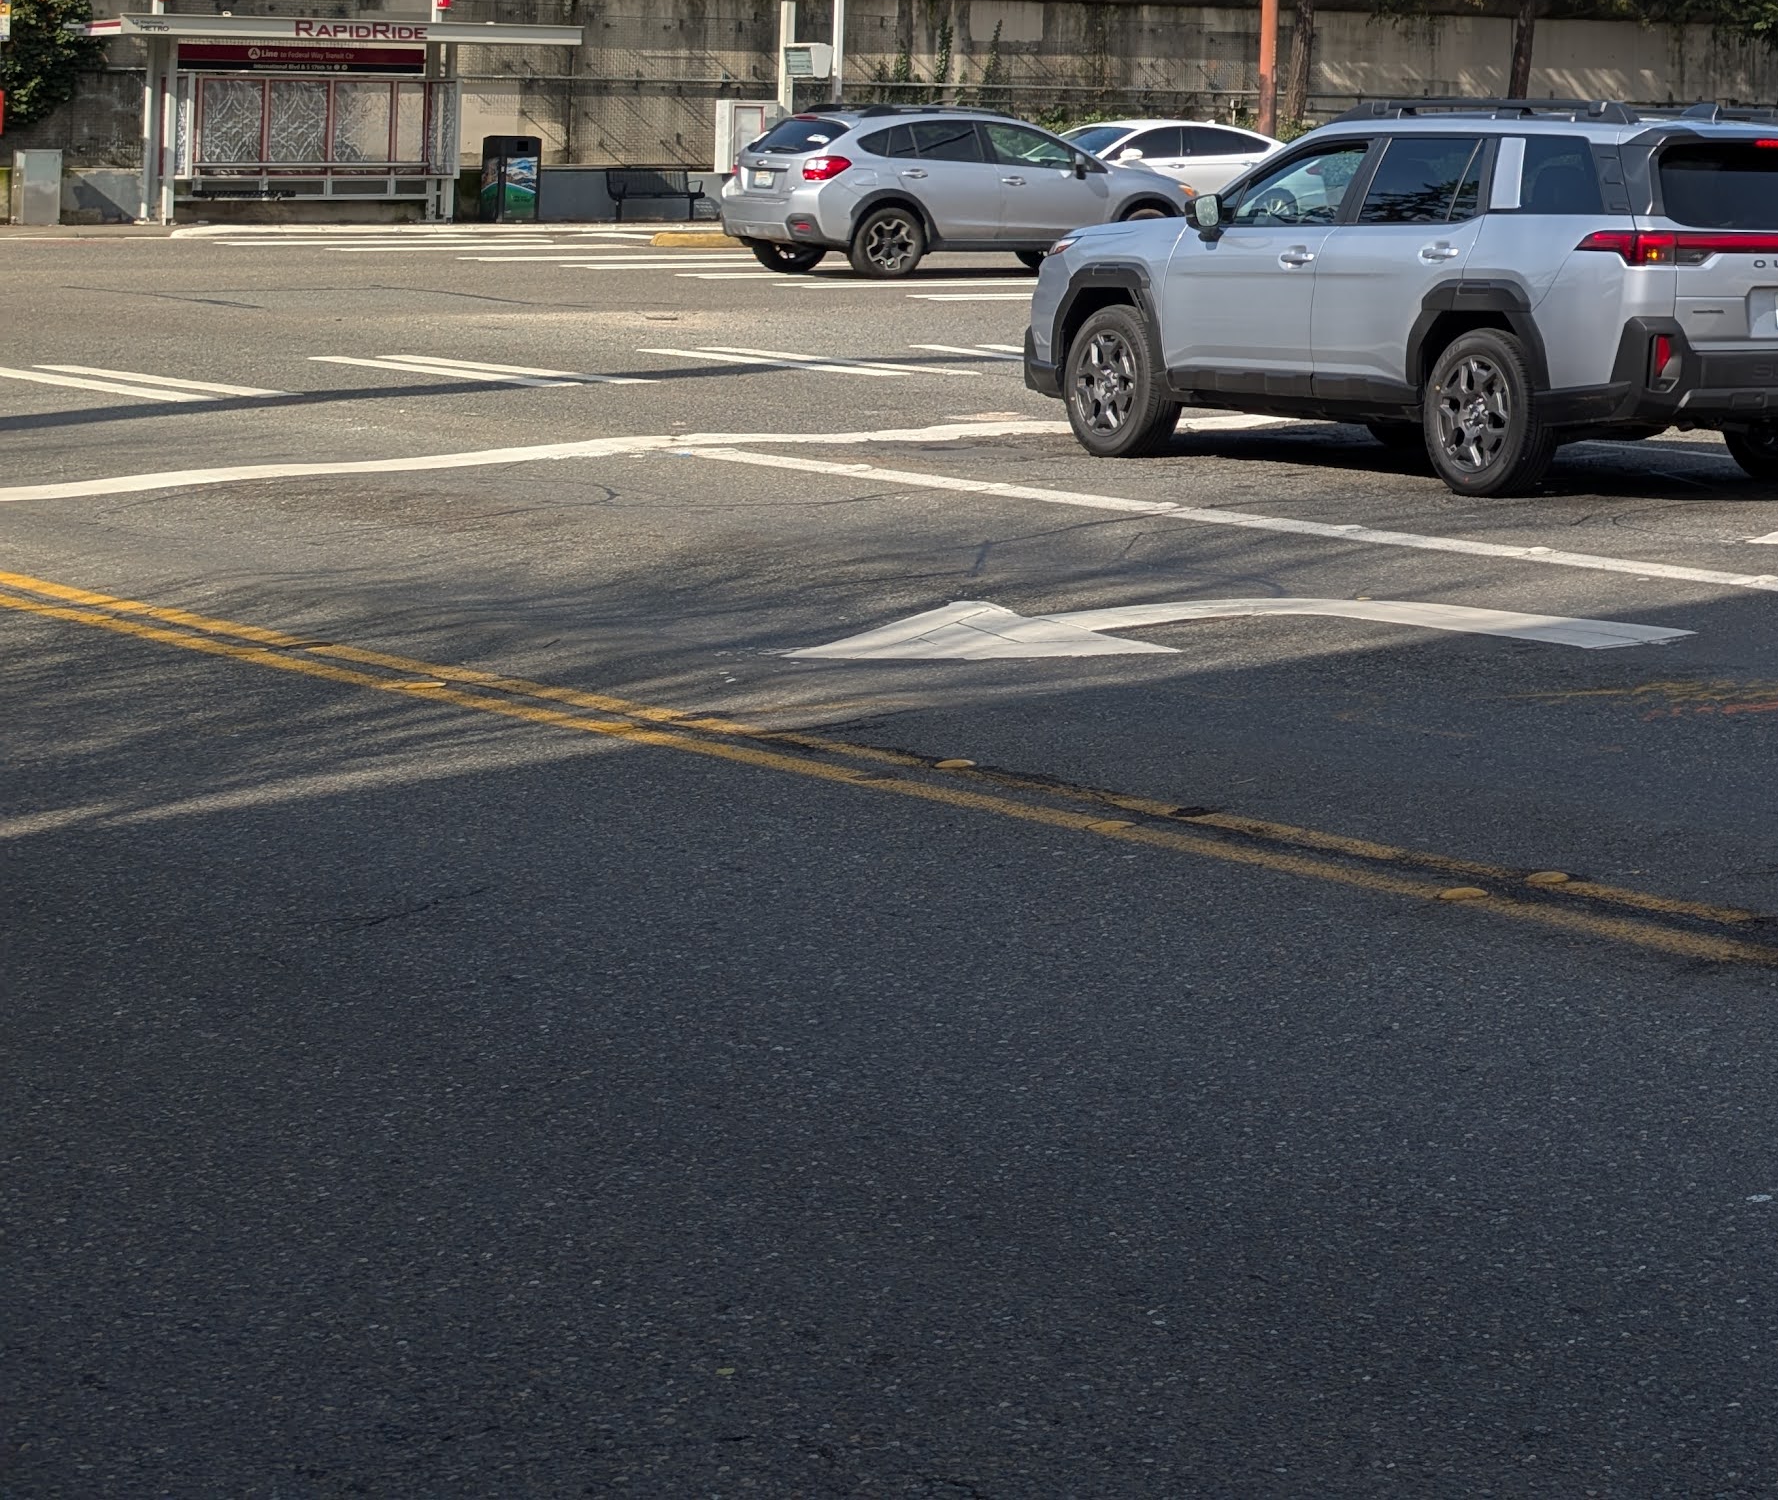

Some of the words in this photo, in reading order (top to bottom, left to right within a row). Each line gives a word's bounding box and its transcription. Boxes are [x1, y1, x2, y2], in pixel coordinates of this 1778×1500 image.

[261, 49, 279, 58] Line
[288, 51, 310, 59] Federal
[311, 52, 324, 60] Way
